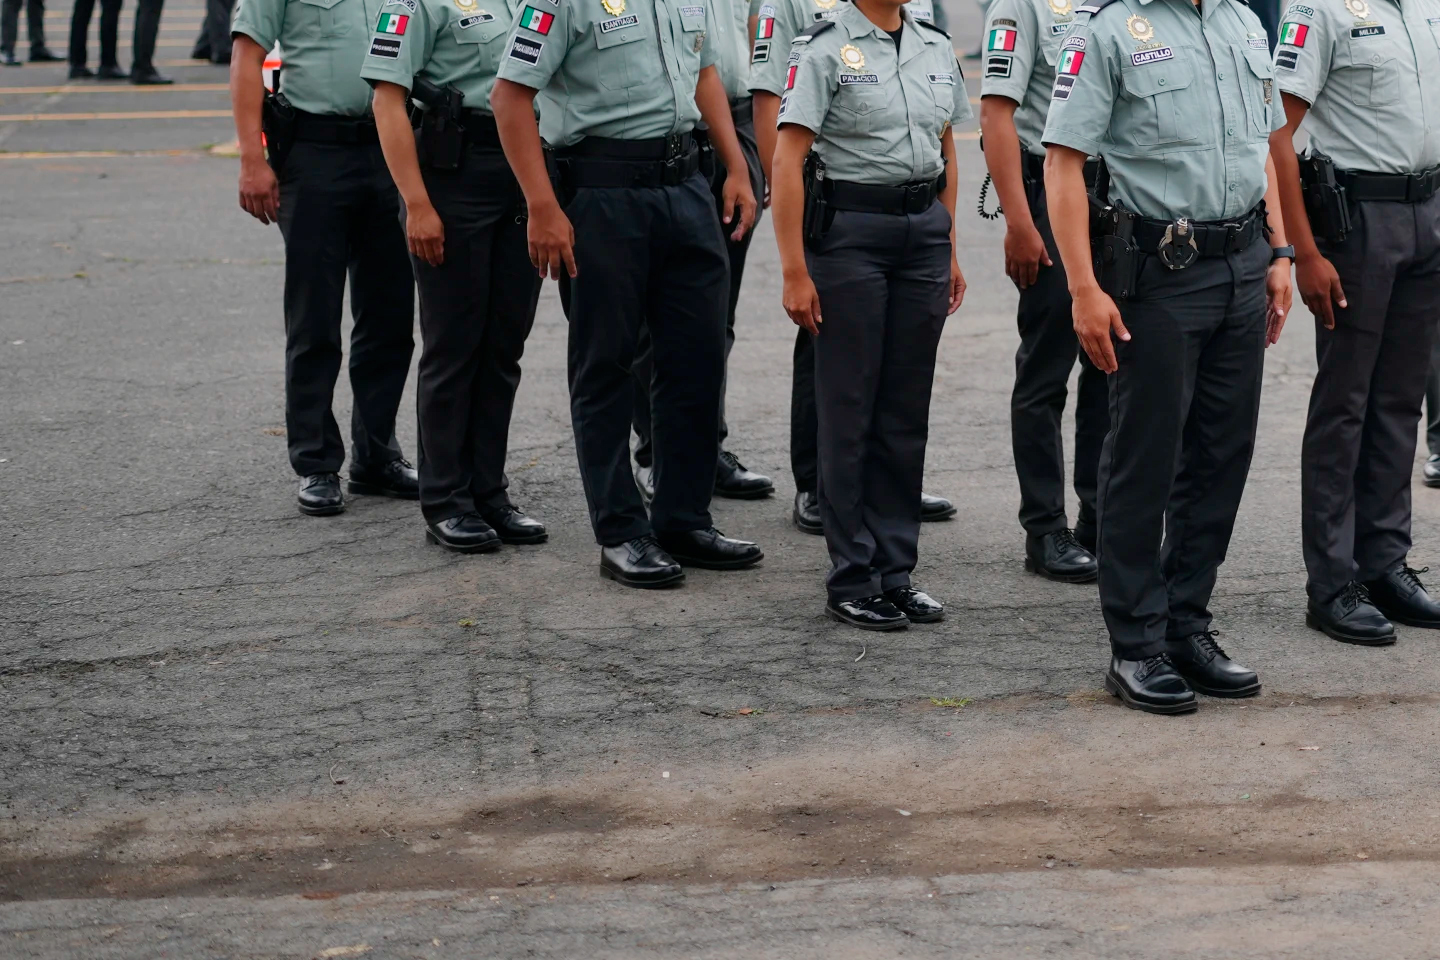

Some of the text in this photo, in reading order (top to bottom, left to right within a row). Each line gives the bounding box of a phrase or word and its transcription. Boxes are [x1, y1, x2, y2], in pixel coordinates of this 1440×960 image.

[468, 16, 485, 25] ROJO
[604, 16, 635, 30] SANTIAGO
[1358, 27, 1379, 36] MILLA
[373, 43, 399, 53] PROXIMIDAD
[513, 41, 539, 57] PROXIMIDAD
[1134, 48, 1171, 61] CASTILLO
[841, 75, 877, 83] PALACIOS
